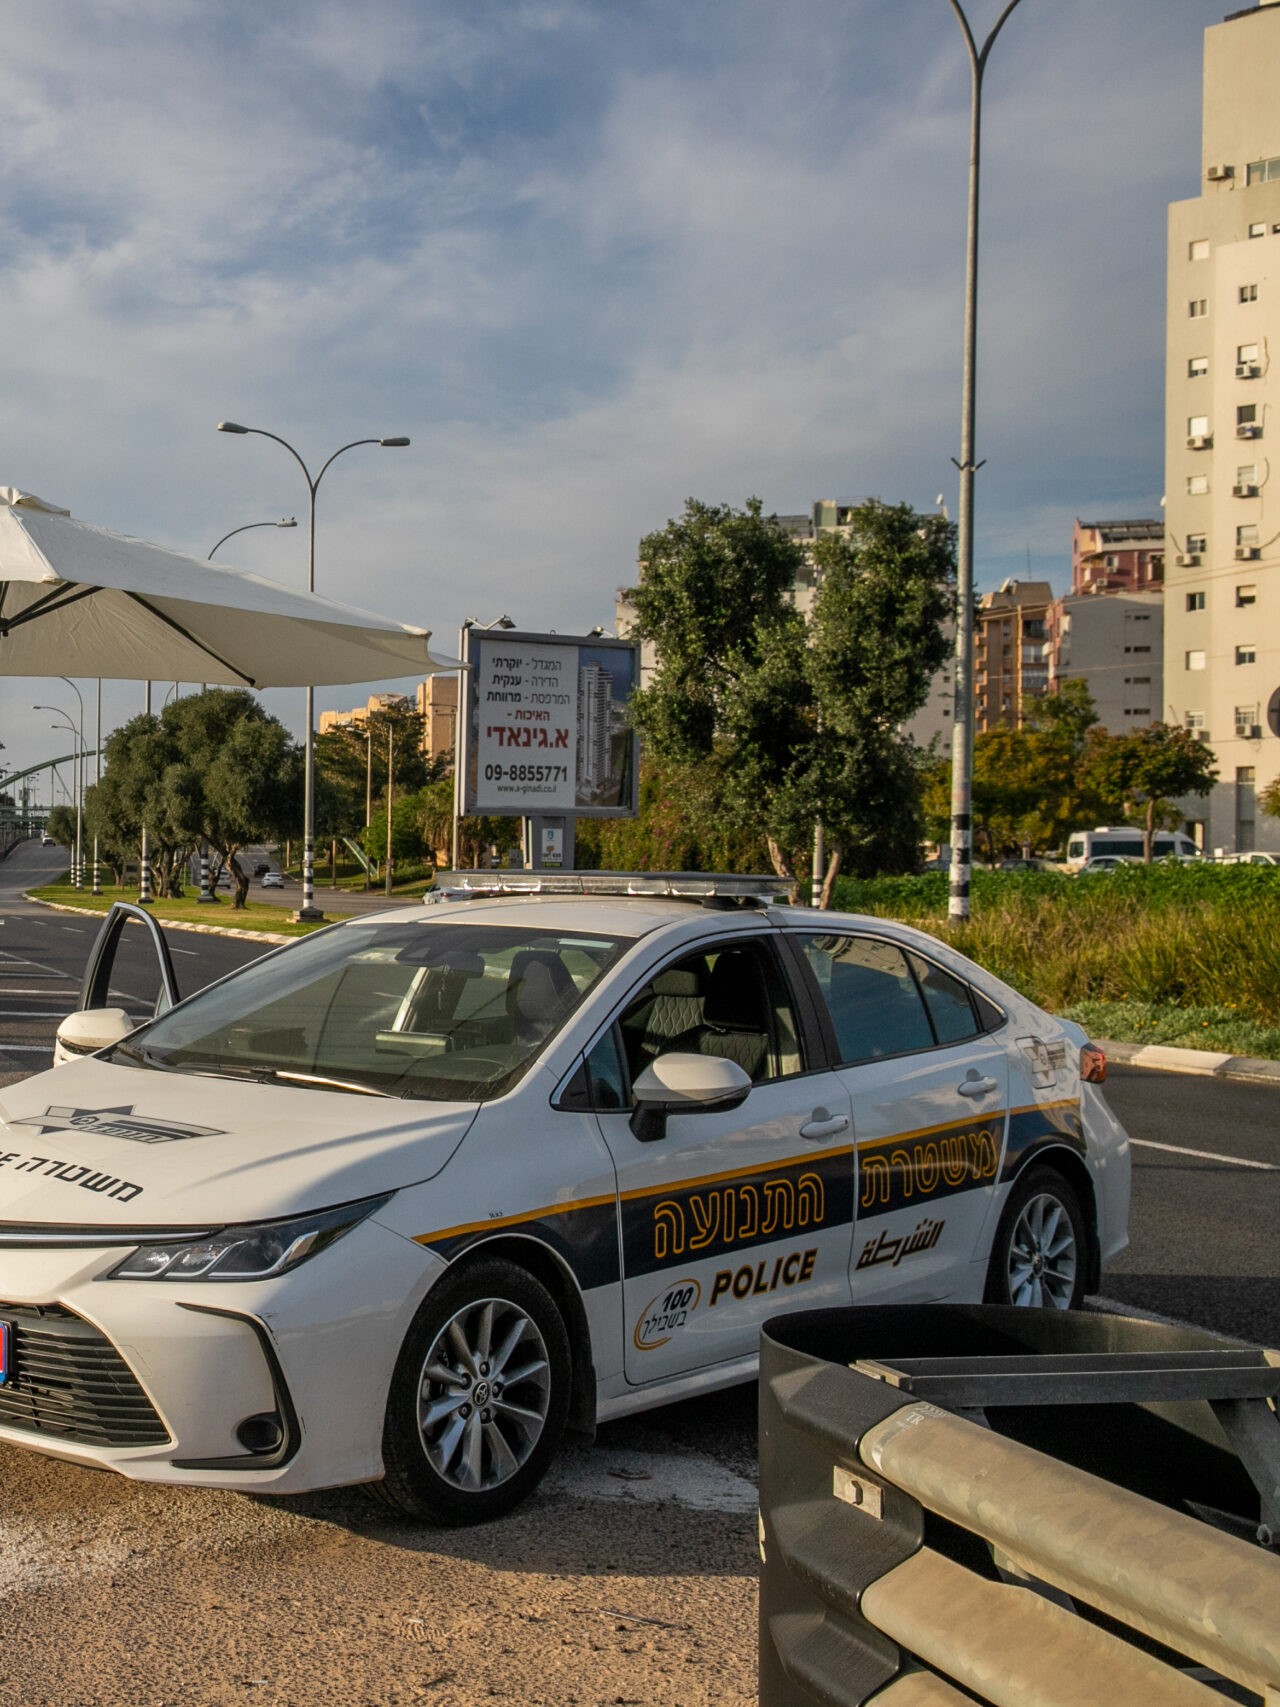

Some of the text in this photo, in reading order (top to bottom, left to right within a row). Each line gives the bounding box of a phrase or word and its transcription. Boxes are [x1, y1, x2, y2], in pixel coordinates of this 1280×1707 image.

[492, 657, 523, 672] יוקרתי
[531, 657, 562, 671] המגדל
[492, 674, 522, 688] ענקית
[531, 676, 559, 688] הדירה
[486, 691, 522, 703] מרווחת
[530, 693, 570, 705] המרפסת
[515, 709, 550, 721] האיכות
[485, 764, 568, 782] 09-8855771
[15, 1156, 144, 1203] משטרה
[654, 1129, 997, 1259] משטרת התנועה
[854, 1217, 946, 1272] الشرطة
[709, 1248, 817, 1306] POLICE
[662, 1286, 694, 1312] 100
[642, 1310, 688, 1340] בשבילך
